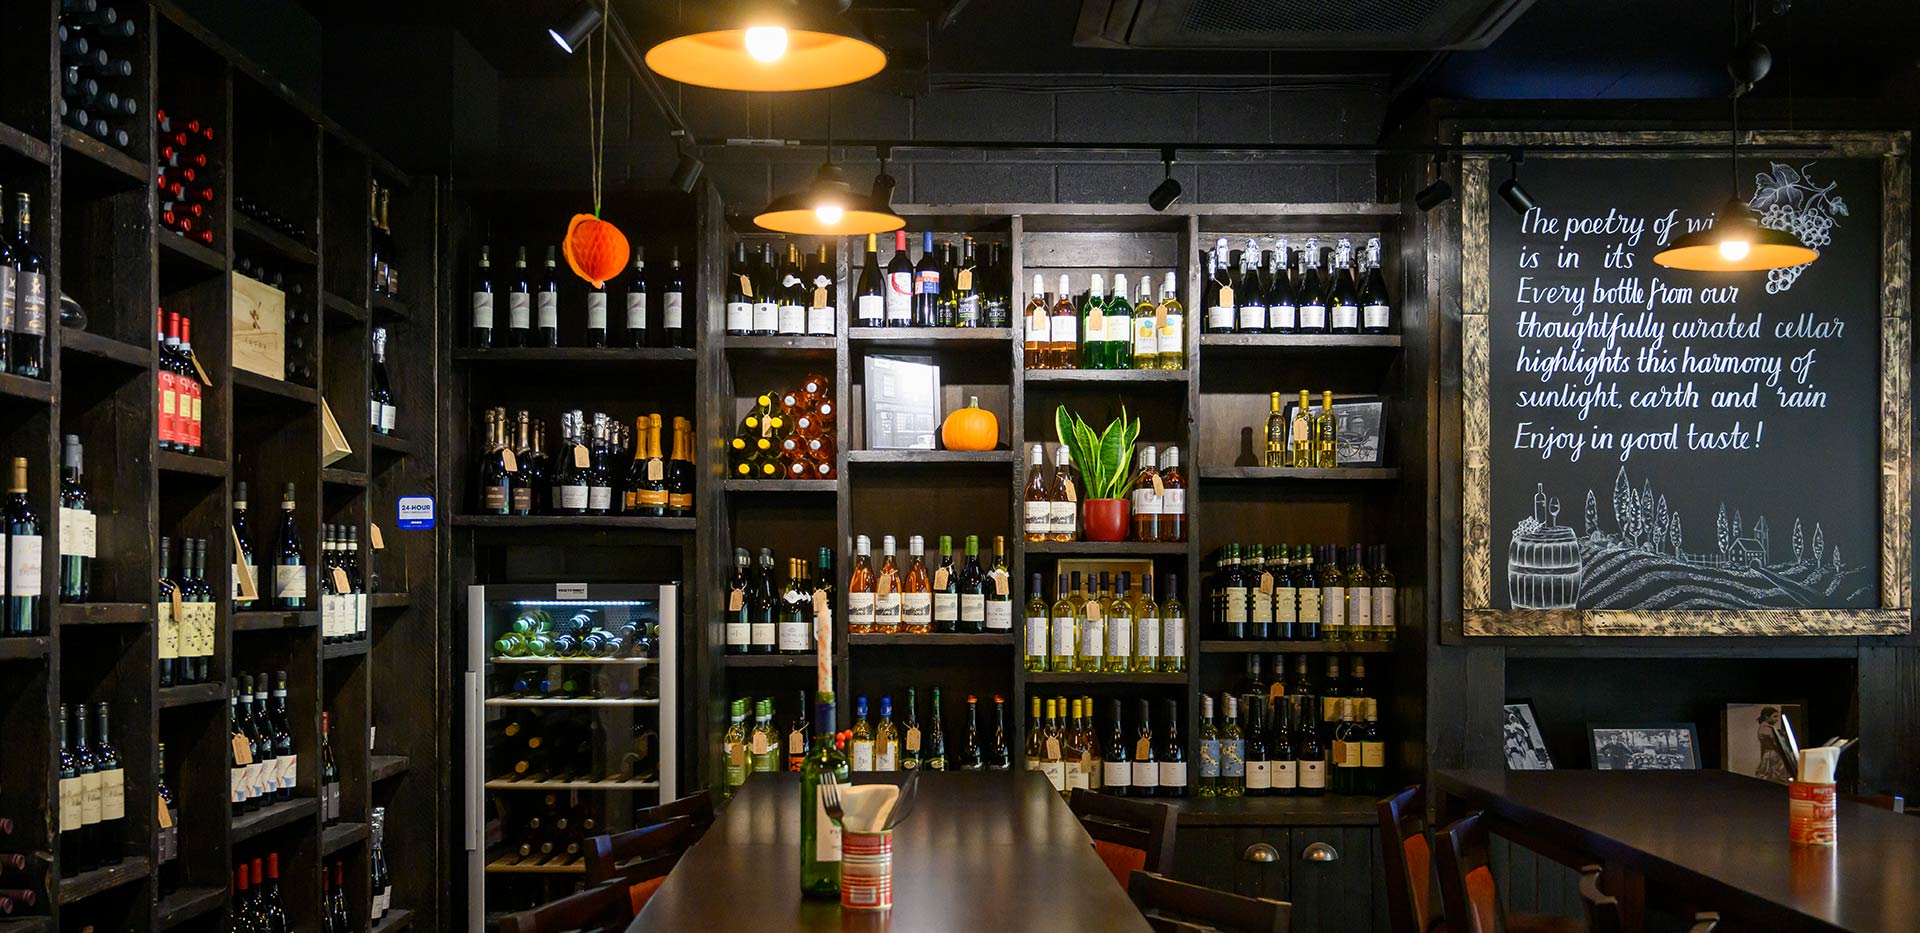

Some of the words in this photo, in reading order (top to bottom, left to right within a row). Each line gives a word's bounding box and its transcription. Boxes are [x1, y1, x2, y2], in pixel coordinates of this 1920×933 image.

[1521, 206, 1559, 233] The
[1564, 208, 1644, 246] poetry
[1654, 209, 1679, 246] of
[1686, 212, 1716, 234] wi
[1520, 246, 1540, 268] is
[1557, 245, 1579, 268] in
[1604, 243, 1635, 268] its
[1517, 277, 1586, 316] Every
[1593, 277, 1645, 303] bottle
[1647, 277, 1693, 310] from
[1700, 285, 1738, 304] our
[1516, 311, 1665, 350] thoughtfully
[1672, 312, 1762, 338] curated
[1775, 312, 1845, 338] cellar
[1516, 346, 1630, 386] highlights
[1637, 346, 1678, 373] this
[1681, 346, 1782, 387] harmony
[1790, 348, 1816, 384] of
[1516, 382, 1622, 421] sunlight,
[1630, 381, 1699, 408] earth
[1711, 382, 1759, 408] and
[1777, 384, 1827, 408] rain
[1514, 421, 1586, 462] Enjoy
[1591, 425, 1613, 449] in
[1620, 423, 1678, 461] good
[1687, 421, 1763, 450] taste!
